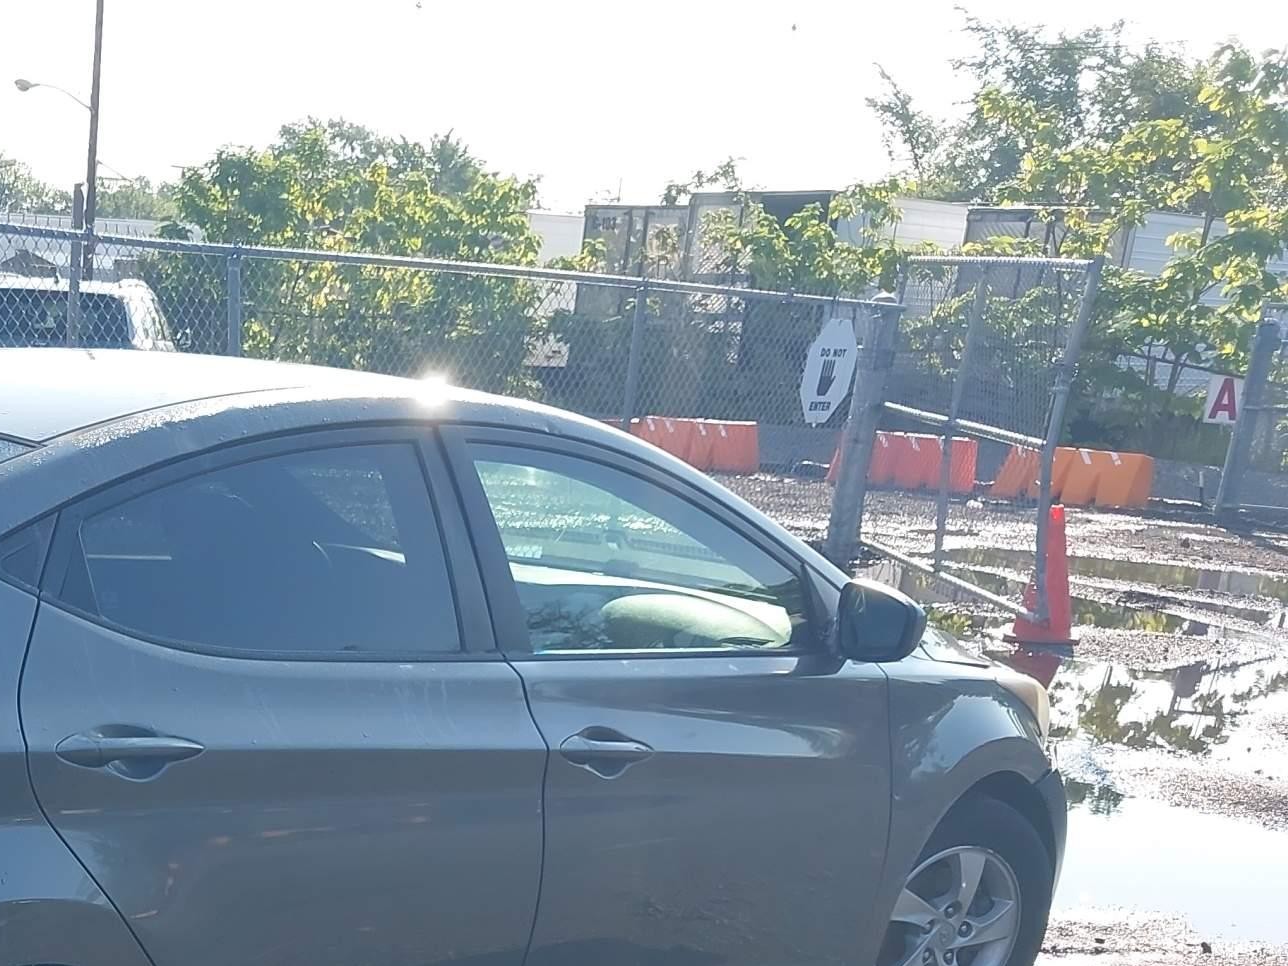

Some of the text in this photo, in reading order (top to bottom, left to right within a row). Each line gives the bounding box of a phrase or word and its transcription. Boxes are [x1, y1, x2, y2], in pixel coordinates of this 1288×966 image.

[820, 347, 847, 359] DO NOT
[1208, 377, 1237, 421] A
[808, 401, 832, 412] ENTER
